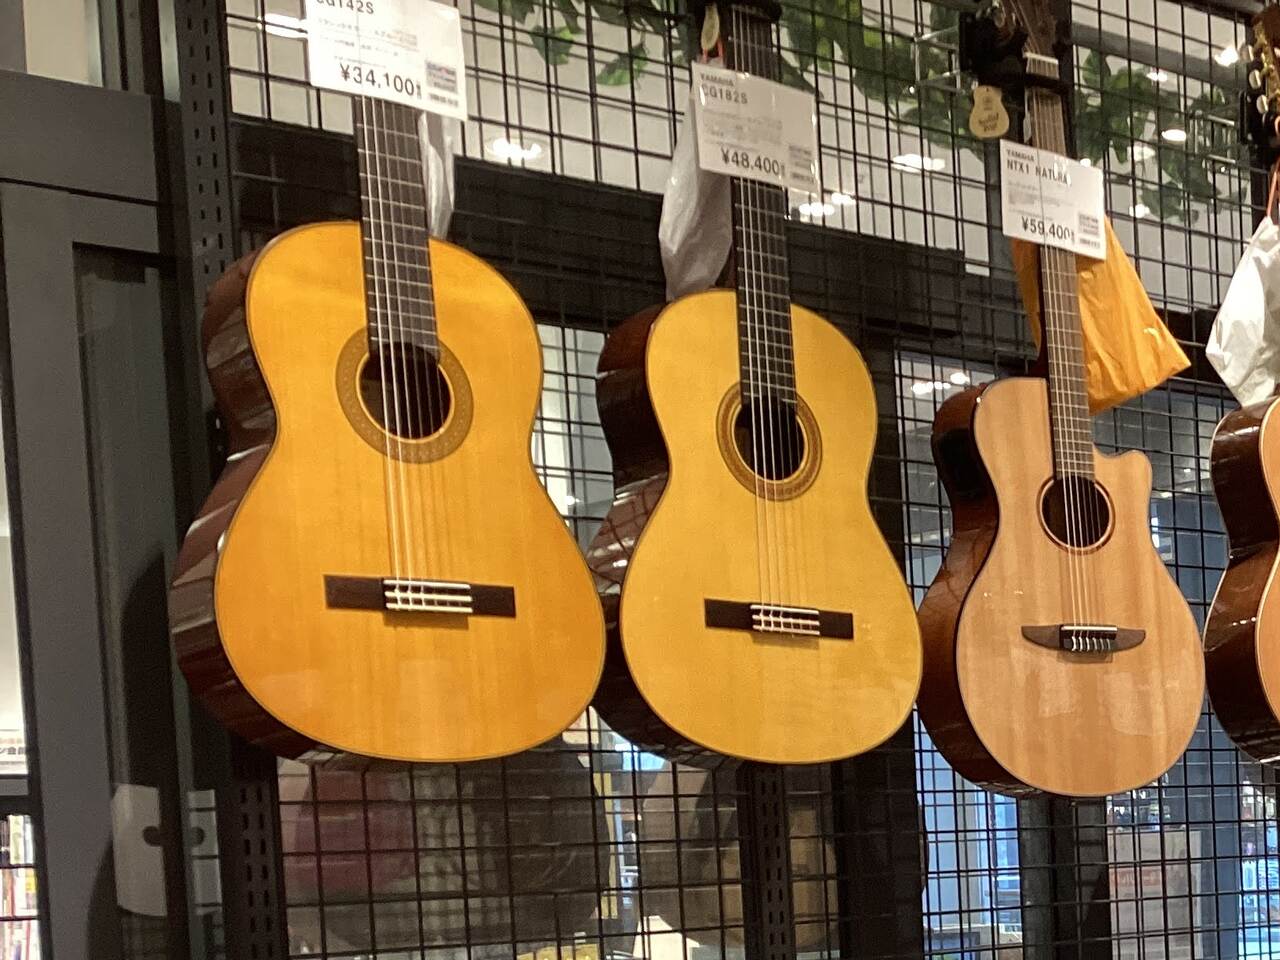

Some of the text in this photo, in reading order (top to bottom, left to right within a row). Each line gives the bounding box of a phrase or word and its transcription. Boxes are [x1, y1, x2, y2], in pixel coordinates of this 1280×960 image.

[340, 63, 415, 96] ¥34,100
[702, 83, 748, 105] CG182S
[721, 146, 780, 176] ¥48,400
[1007, 159, 1029, 175] NTX1
[1021, 215, 1070, 241] ¥59,400
